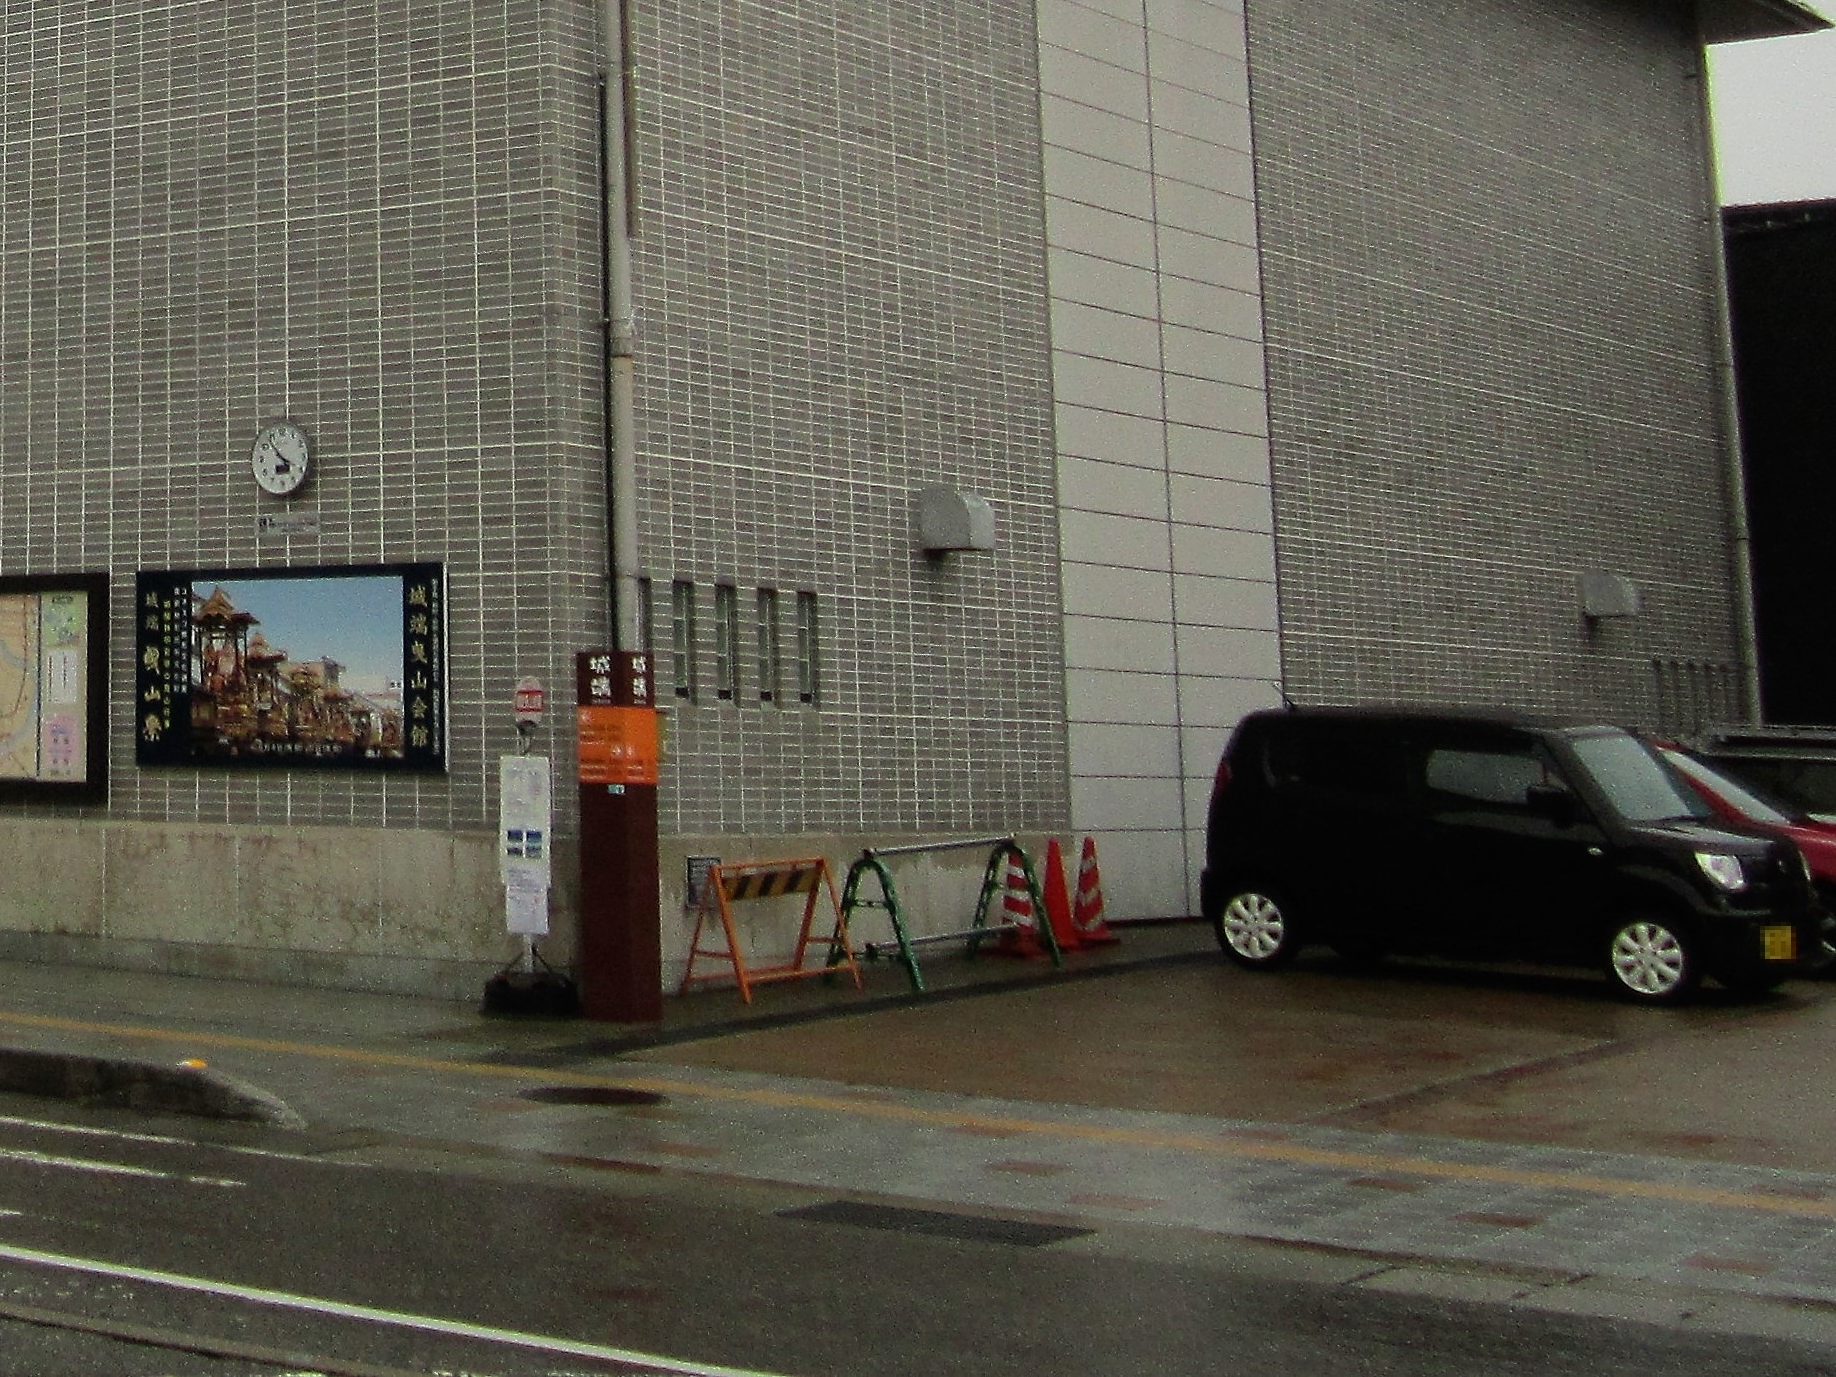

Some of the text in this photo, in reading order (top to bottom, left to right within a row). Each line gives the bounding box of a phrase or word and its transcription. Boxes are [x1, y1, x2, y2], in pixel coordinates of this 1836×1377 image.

[408, 584, 428, 748] 城端曳山会館
[589, 655, 612, 698] 城端
